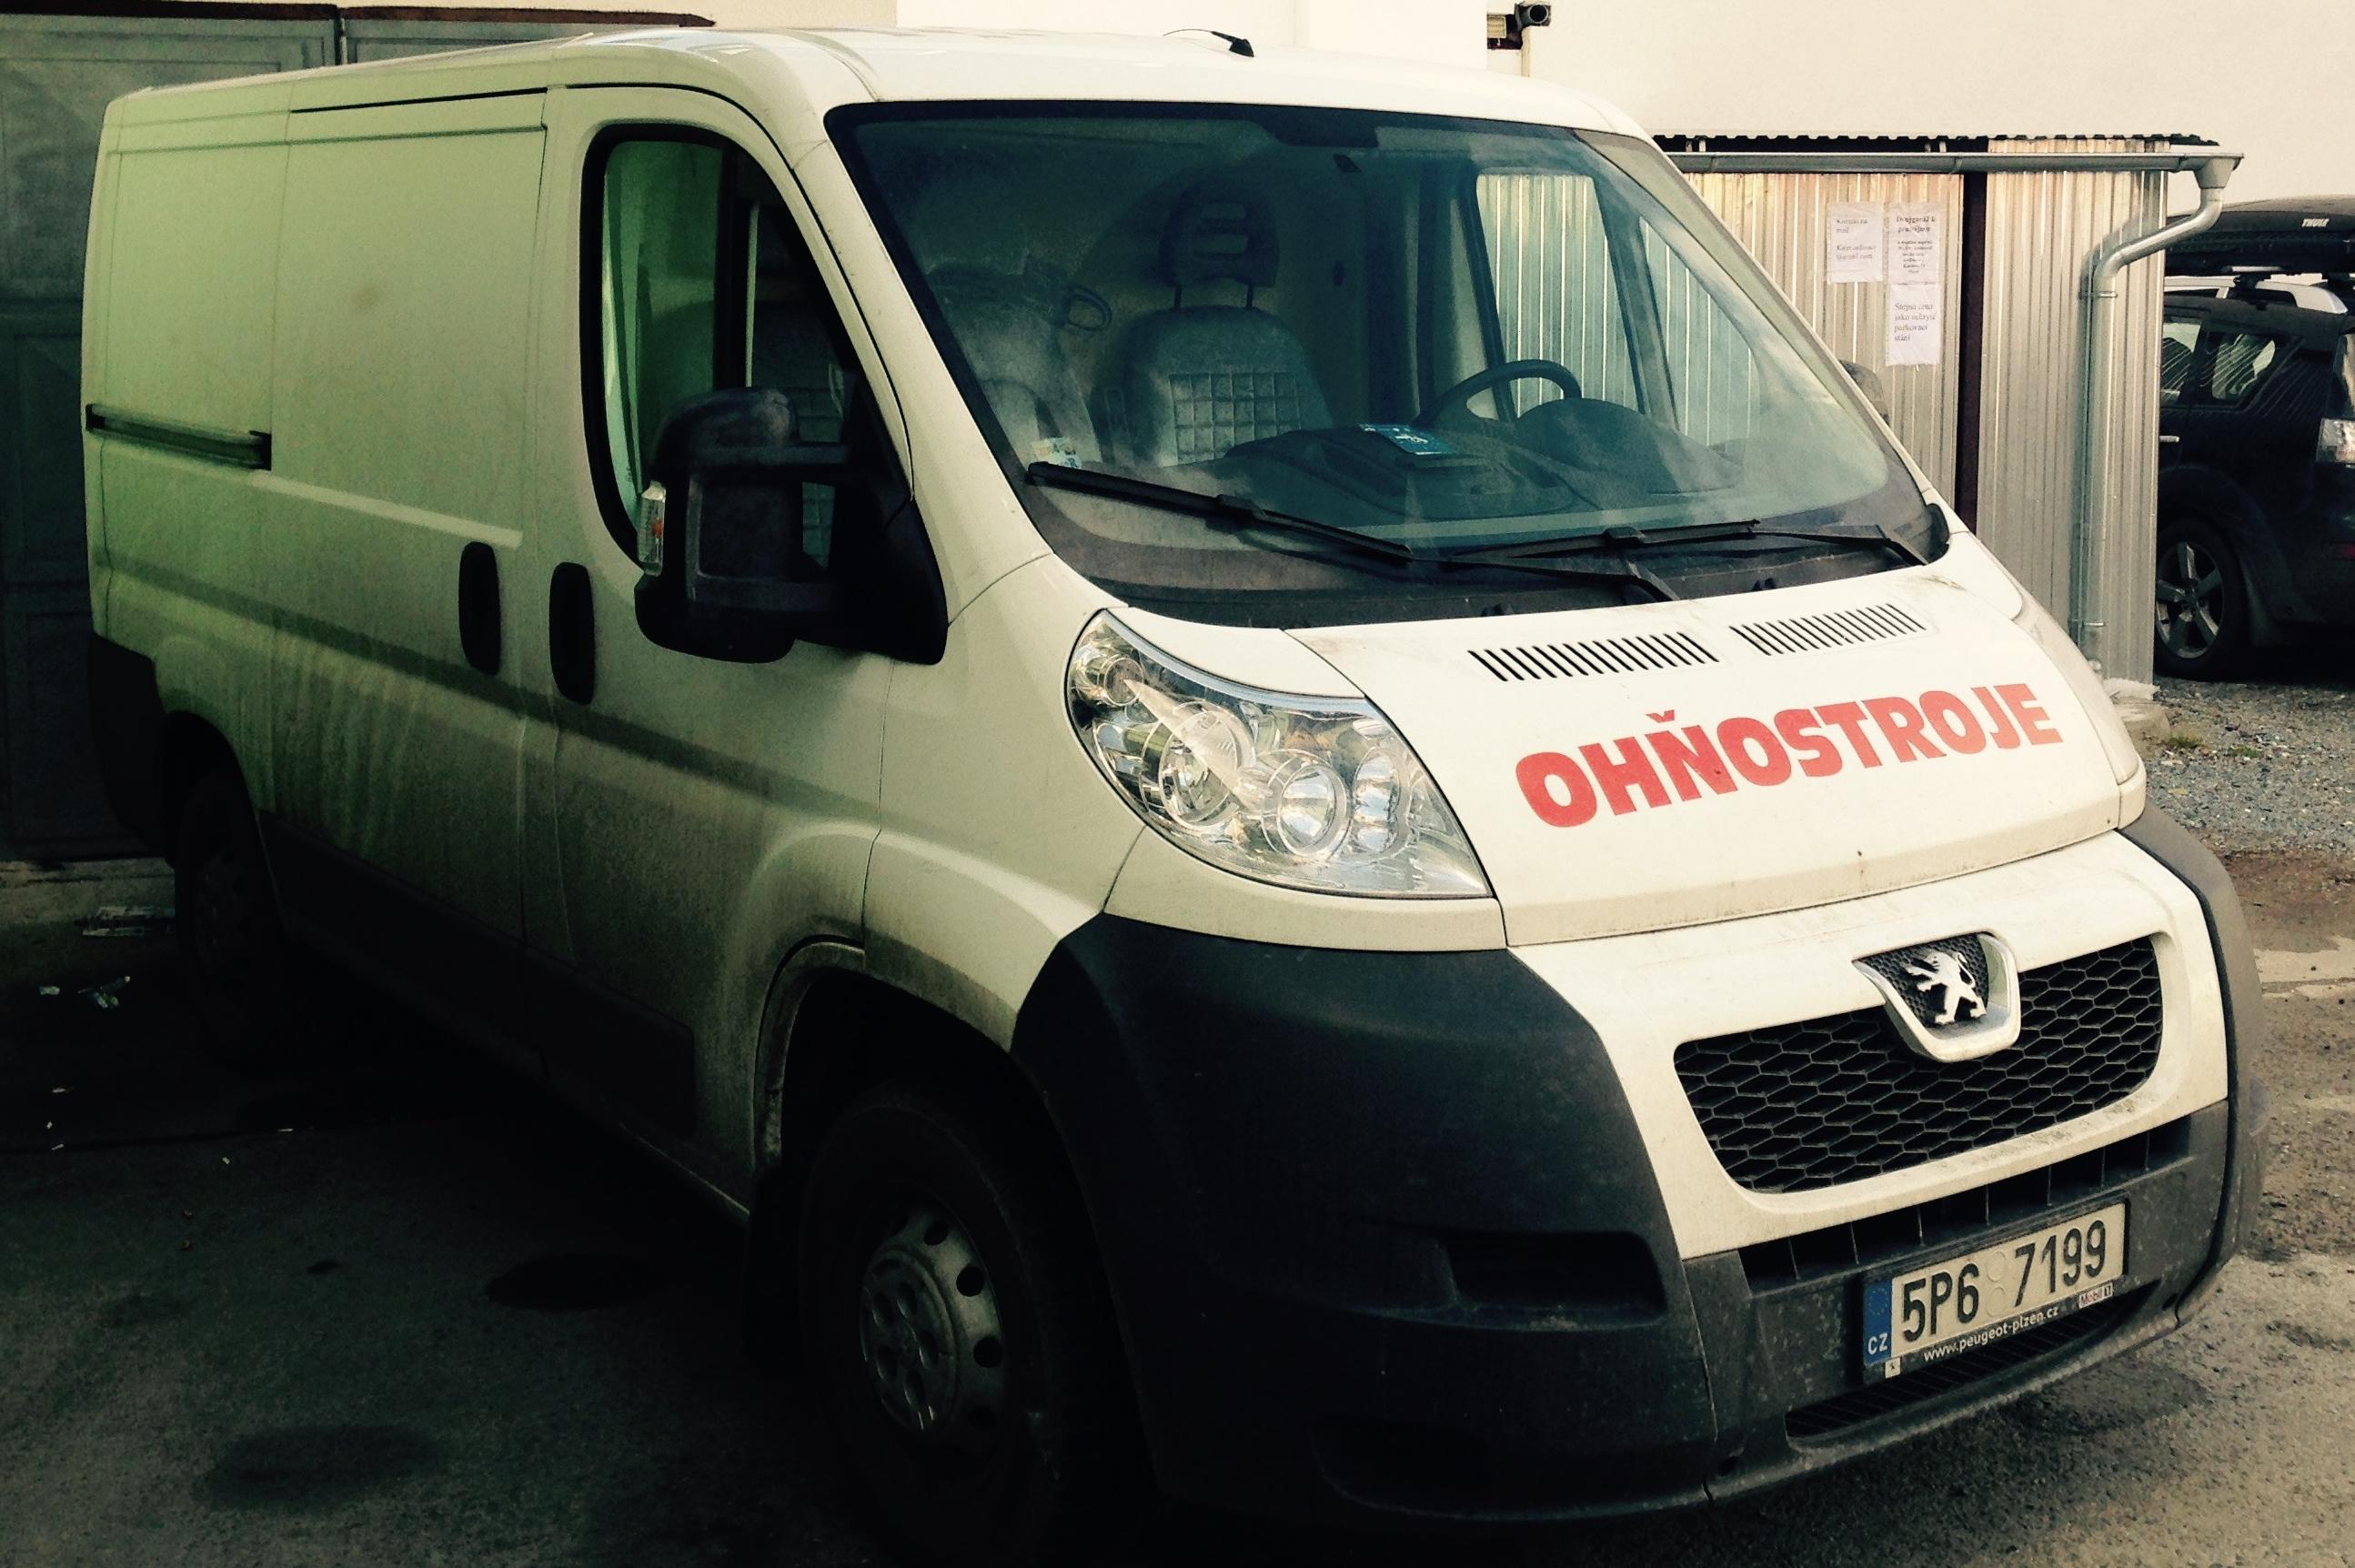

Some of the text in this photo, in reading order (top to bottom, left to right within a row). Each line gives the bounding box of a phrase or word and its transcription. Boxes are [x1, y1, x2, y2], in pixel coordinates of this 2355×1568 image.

[1515, 683, 2064, 828] OHŇOSTROJE
[1903, 1220, 2107, 1342] 5P6 7199
[1867, 1333, 1888, 1355] CZ
[1923, 1306, 2059, 1362] www.peugeot-plzen.cz
